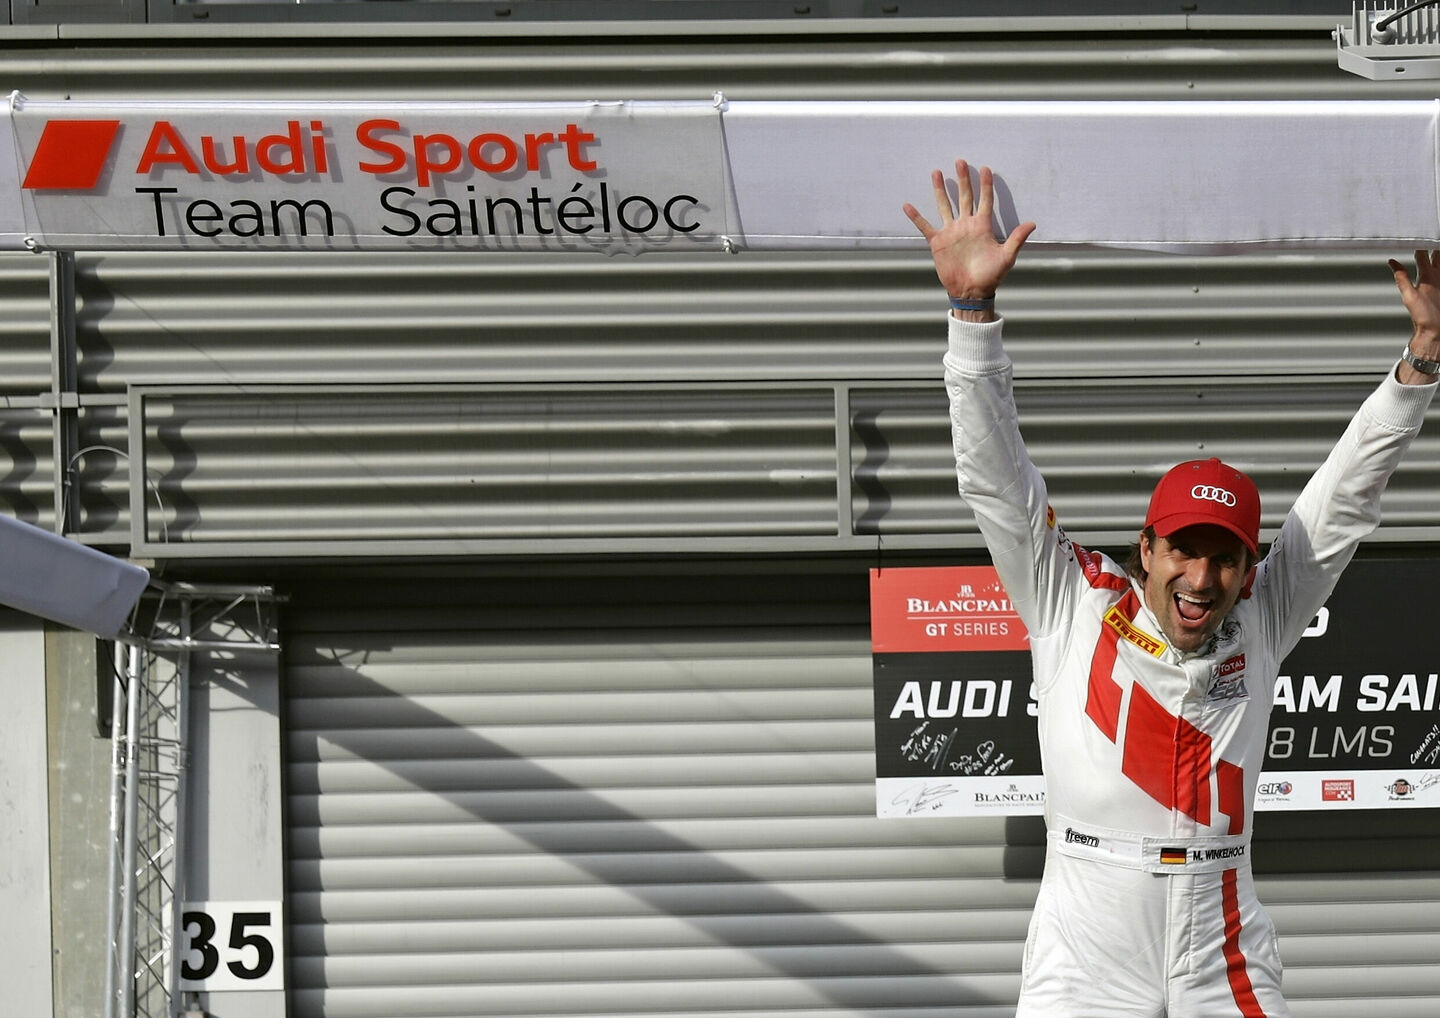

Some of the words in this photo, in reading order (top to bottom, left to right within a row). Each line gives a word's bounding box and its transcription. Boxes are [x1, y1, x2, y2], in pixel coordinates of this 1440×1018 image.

[136, 120, 328, 175] Audi
[357, 119, 597, 188] Sport
[135, 187, 335, 238] Team
[380, 183, 701, 238] Saintéloc
[926, 623, 947, 636] GT
[953, 622, 1009, 636] SERIES
[1109, 612, 1161, 655] PIRELLI
[1220, 660, 1244, 672] TOTAL
[890, 680, 1012, 718] AUDI
[1273, 675, 1343, 713] AM
[1268, 727, 1295, 759] 8
[1308, 725, 1395, 759] LMS
[1065, 828, 1099, 847] freem
[181, 911, 274, 980] 35
